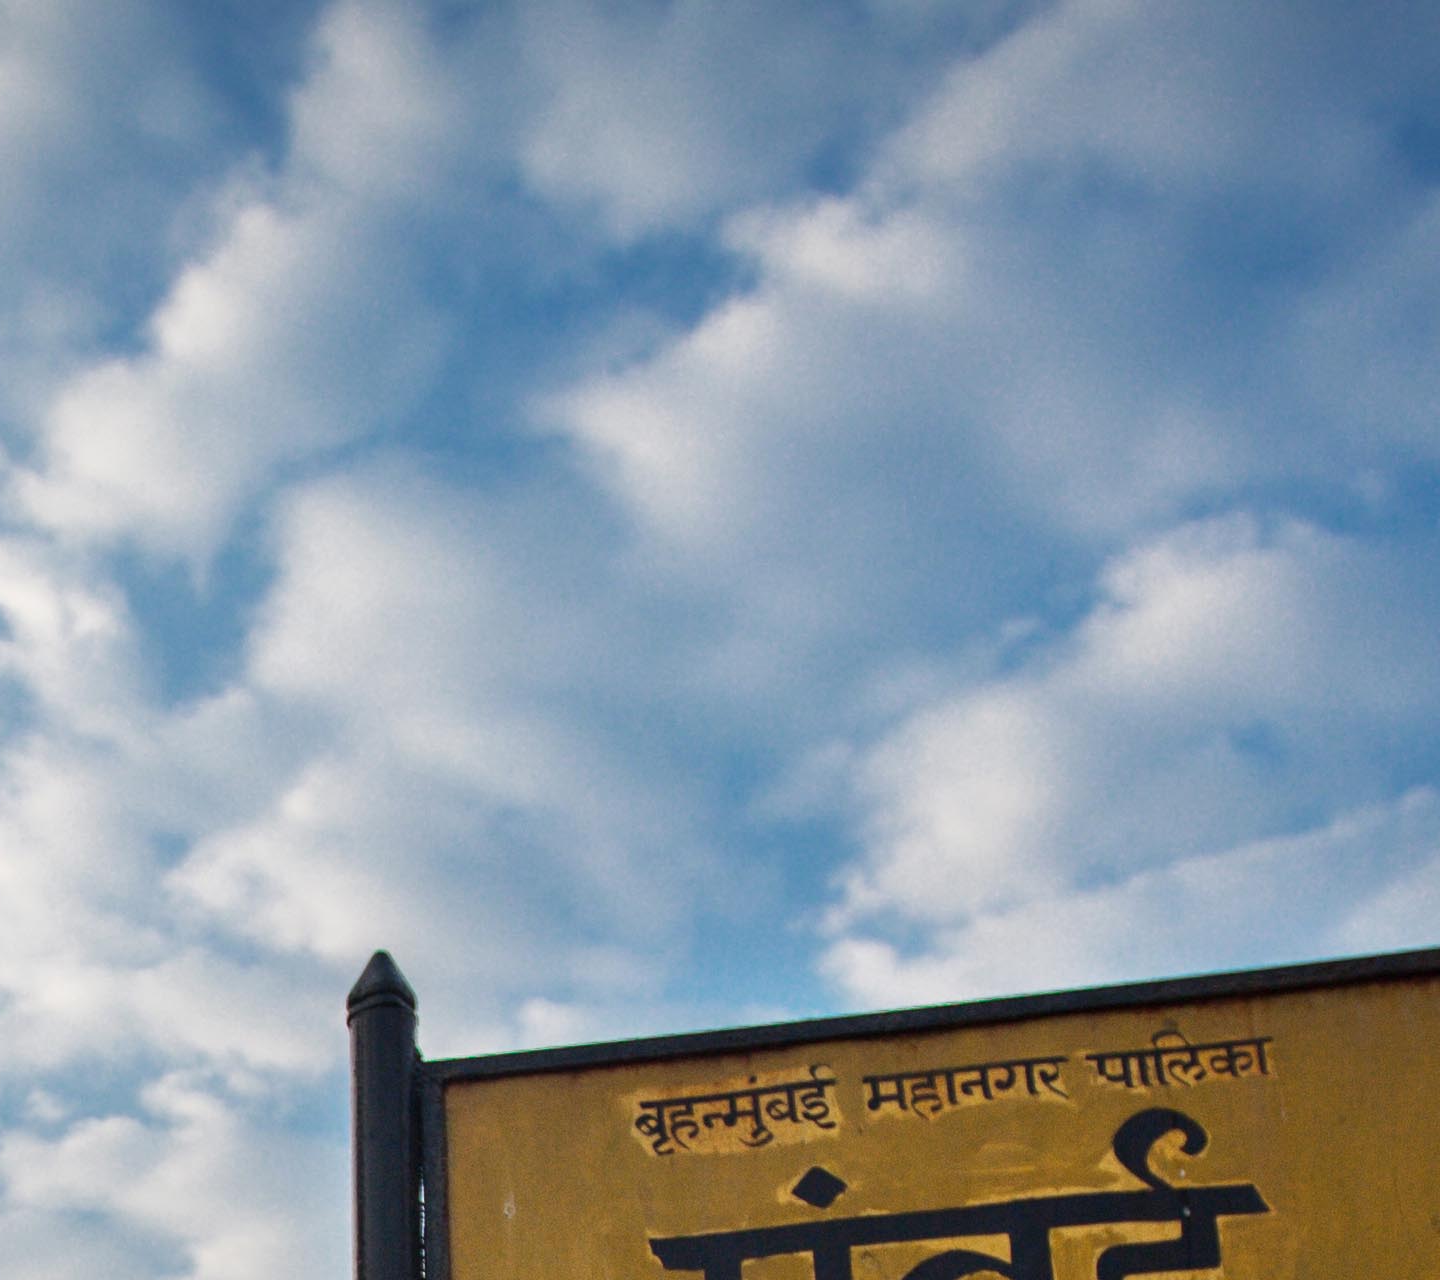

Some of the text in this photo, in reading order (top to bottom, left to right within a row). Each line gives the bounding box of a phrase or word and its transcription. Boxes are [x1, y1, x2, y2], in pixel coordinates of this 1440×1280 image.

[634, 1028, 1274, 1156] बृहन्मुंबई महानगर पालिका
